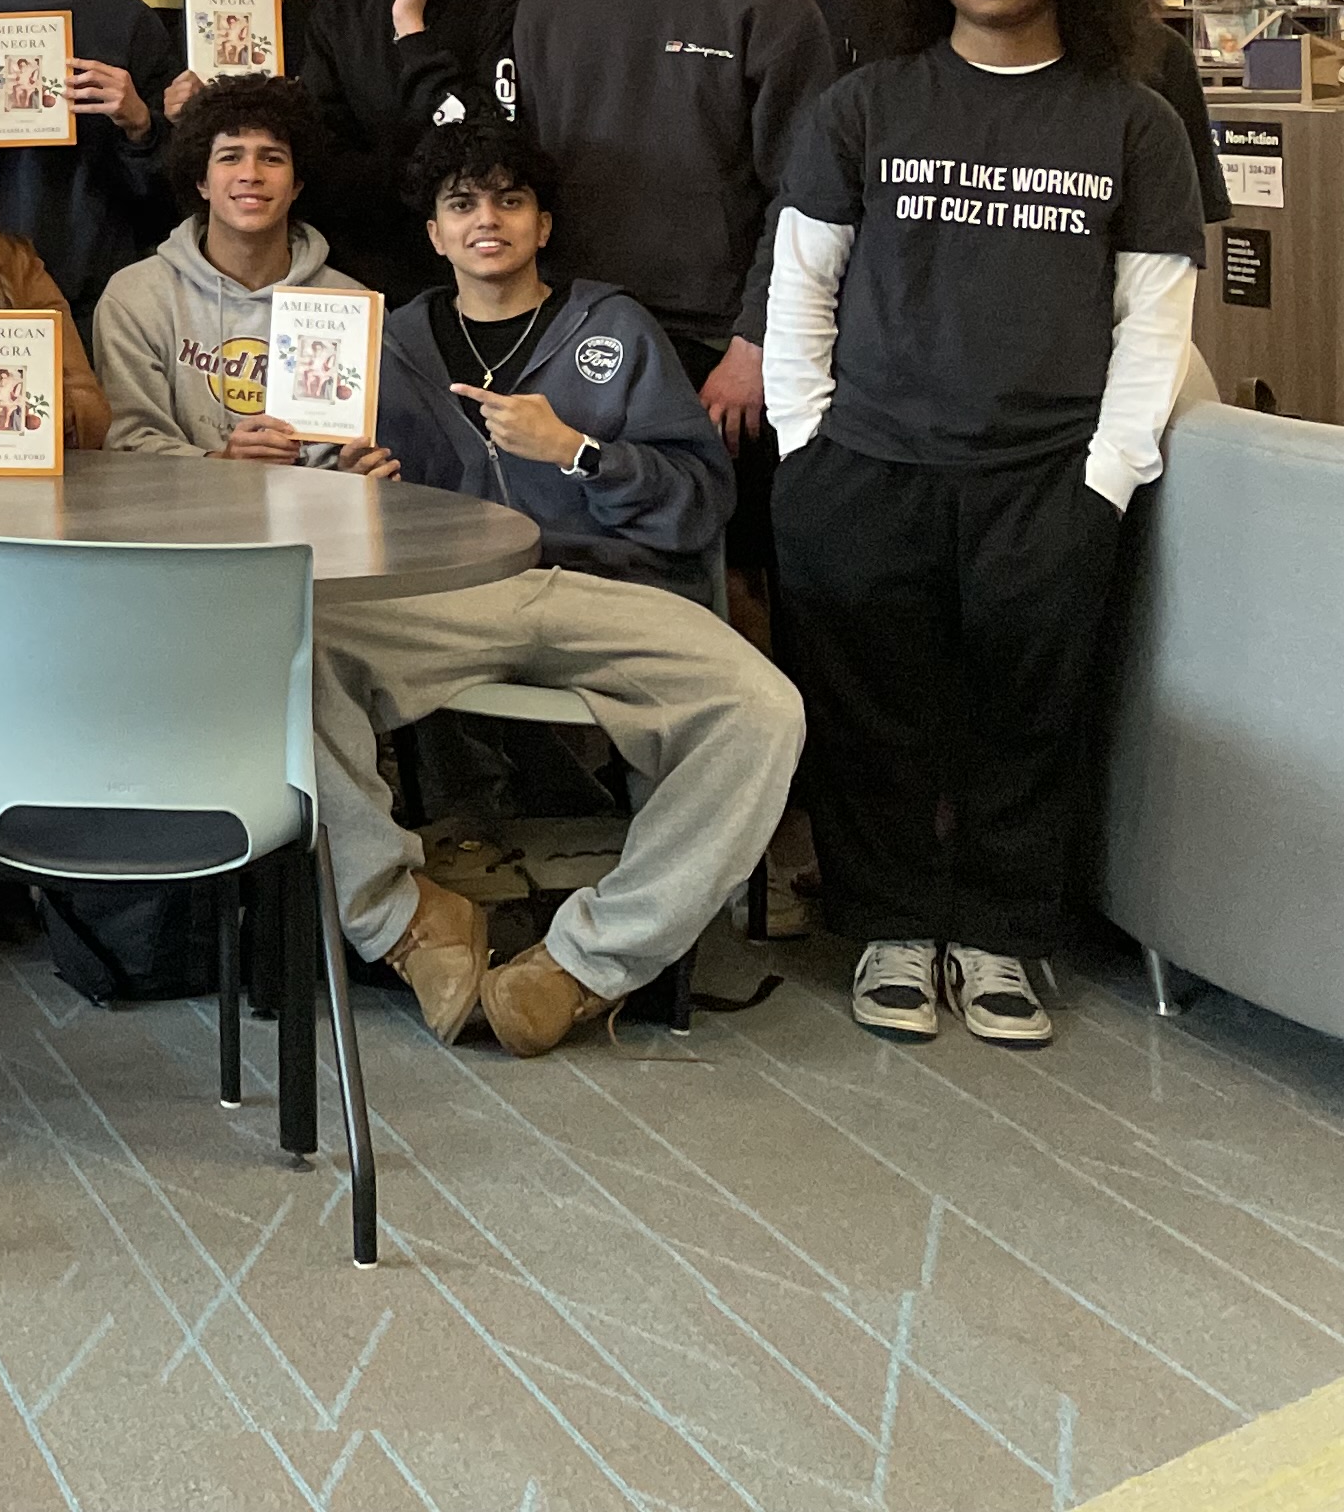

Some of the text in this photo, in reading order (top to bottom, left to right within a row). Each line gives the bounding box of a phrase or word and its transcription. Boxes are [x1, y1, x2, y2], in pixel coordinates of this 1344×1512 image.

[0, 39, 46, 49] NEGRA
[1225, 129, 1279, 146] Non-Fiction
[880, 158, 1114, 201] I DON'T LIKE WORKING
[896, 195, 1091, 235] OUT CUZ IT HURTS.
[279, 301, 362, 315] AMERICAN
[293, 318, 346, 331] NEGRA
[178, 338, 249, 378] Hard
[579, 348, 618, 369] Ford
[227, 388, 264, 403] CAFE
